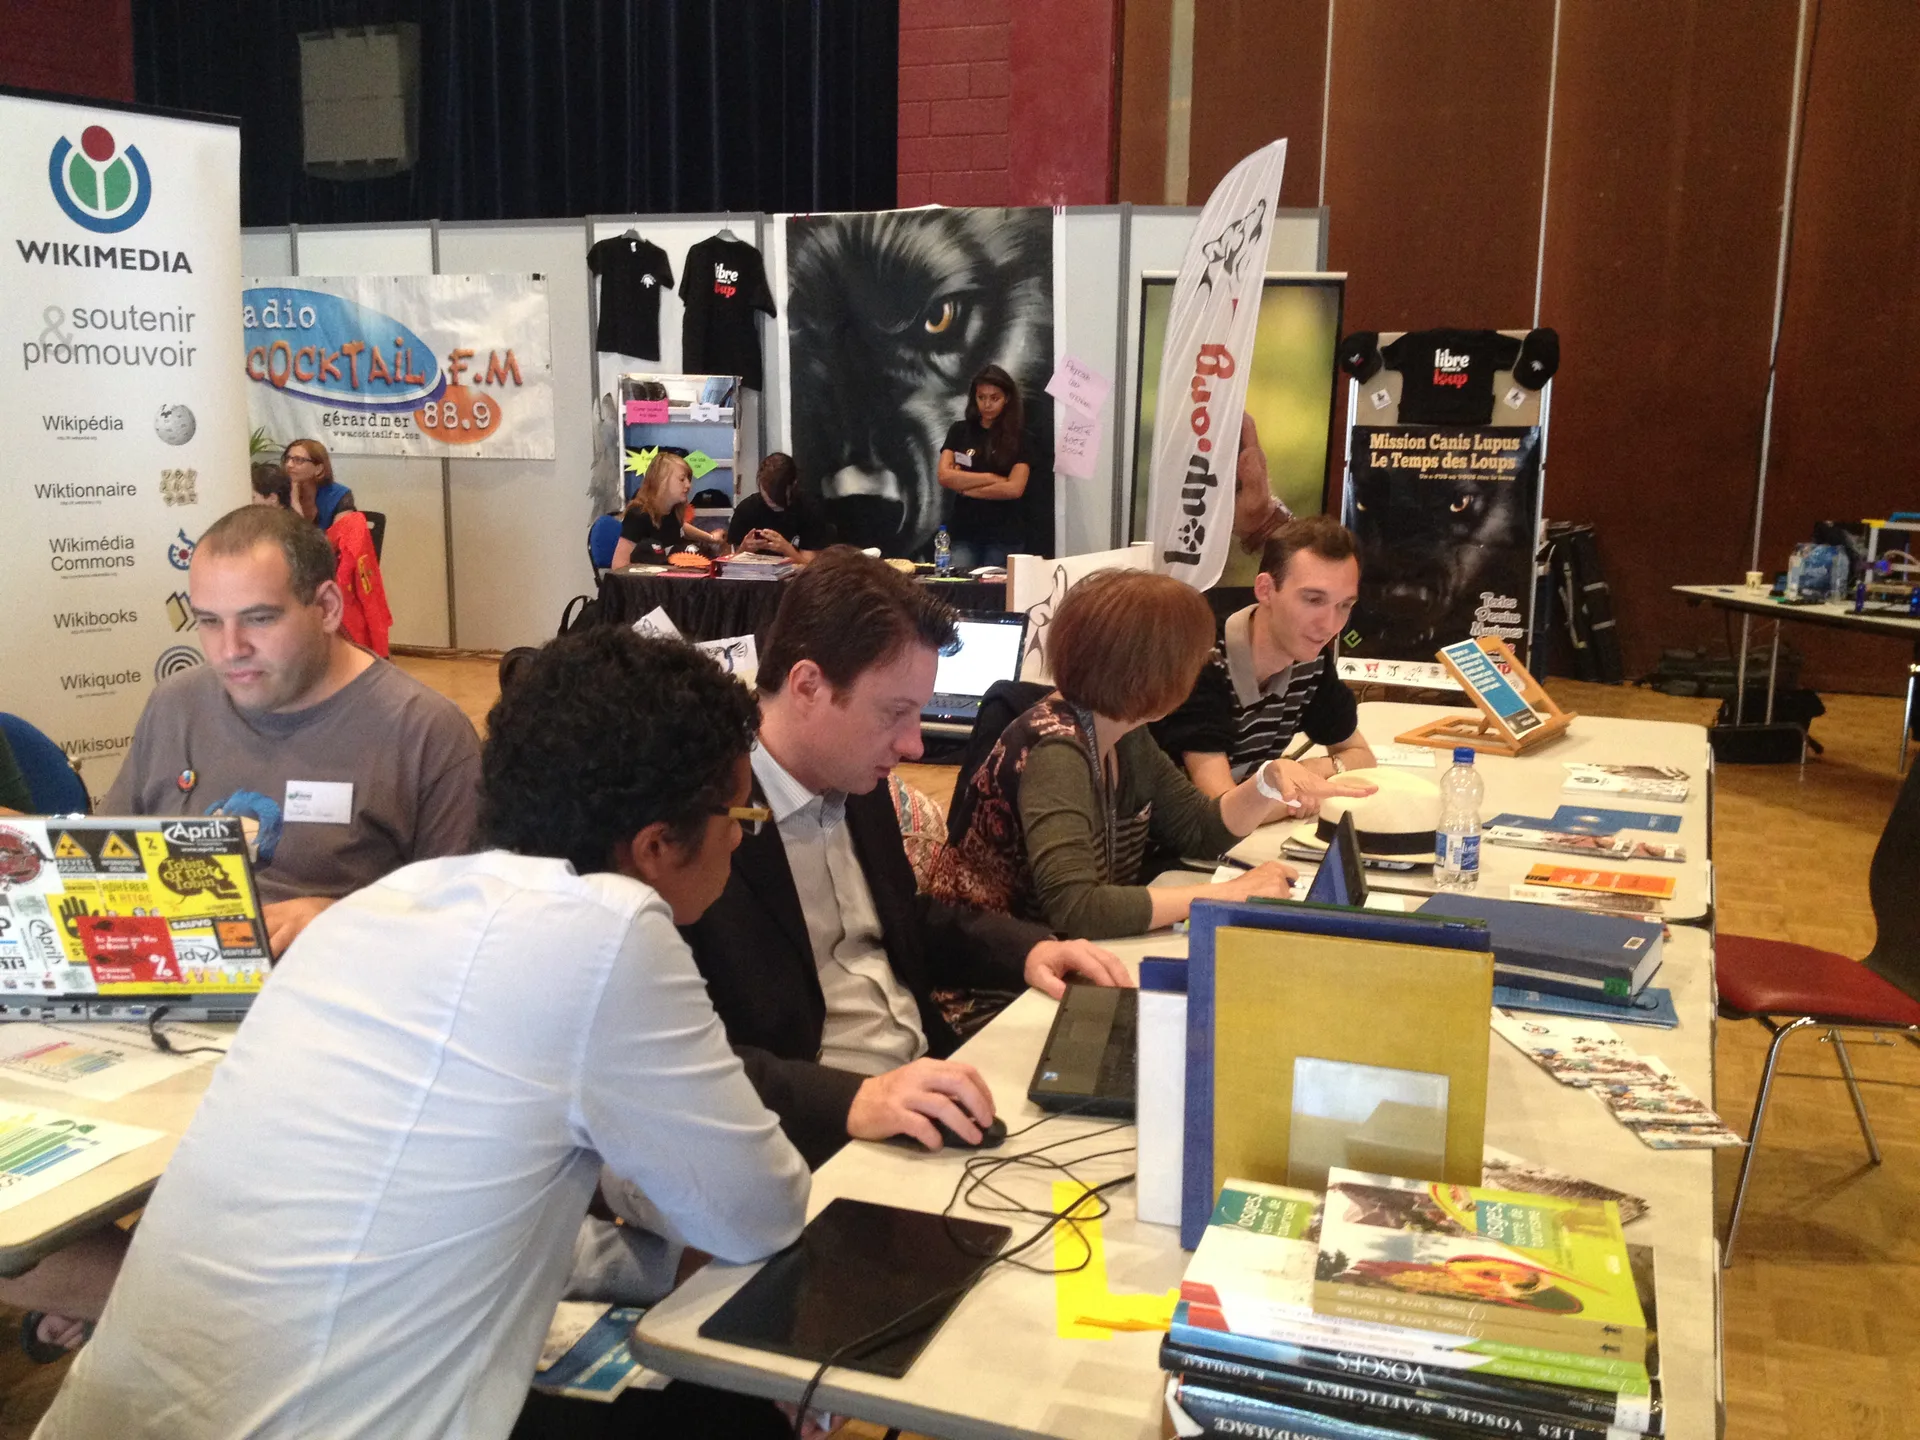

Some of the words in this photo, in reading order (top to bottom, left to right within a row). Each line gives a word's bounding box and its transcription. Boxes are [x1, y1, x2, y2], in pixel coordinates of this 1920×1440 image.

[16, 239, 193, 274] WIKIMEDIA
[72, 304, 196, 333] soutenir
[242, 298, 316, 329] adio
[22, 340, 197, 371] promouvoir
[1434, 348, 1470, 368] libre
[42, 415, 124, 434] Wikipédia
[322, 410, 411, 429] gérardmer
[423, 400, 492, 430] 88.9
[1369, 432, 1427, 451] Mission
[1428, 432, 1471, 451] Canis
[1473, 433, 1521, 455] Lupus
[1370, 451, 1388, 468] Le
[1390, 452, 1439, 472] Temps
[1441, 452, 1468, 469] des
[1470, 452, 1517, 473] Loups
[34, 482, 137, 499] Wiktionnaire
[49, 536, 135, 553] Wikimédia
[51, 555, 135, 572] Commons
[53, 609, 138, 629] Wikibooks
[60, 670, 141, 690] Wikiquote
[60, 735, 135, 755] Wikisour
[171, 821, 225, 843] April
[163, 870, 181, 883] or
[185, 866, 216, 879] not
[165, 858, 206, 871] Tobin
[175, 877, 217, 891] Tobin
[177, 948, 211, 964] Apr
[1335, 1351, 1427, 1386] VOSGES
[1303, 1379, 1433, 1416] S'AFFICHENT
[1446, 1405, 1524, 1433] VOSGES
[1537, 1422, 1576, 1440] LES
